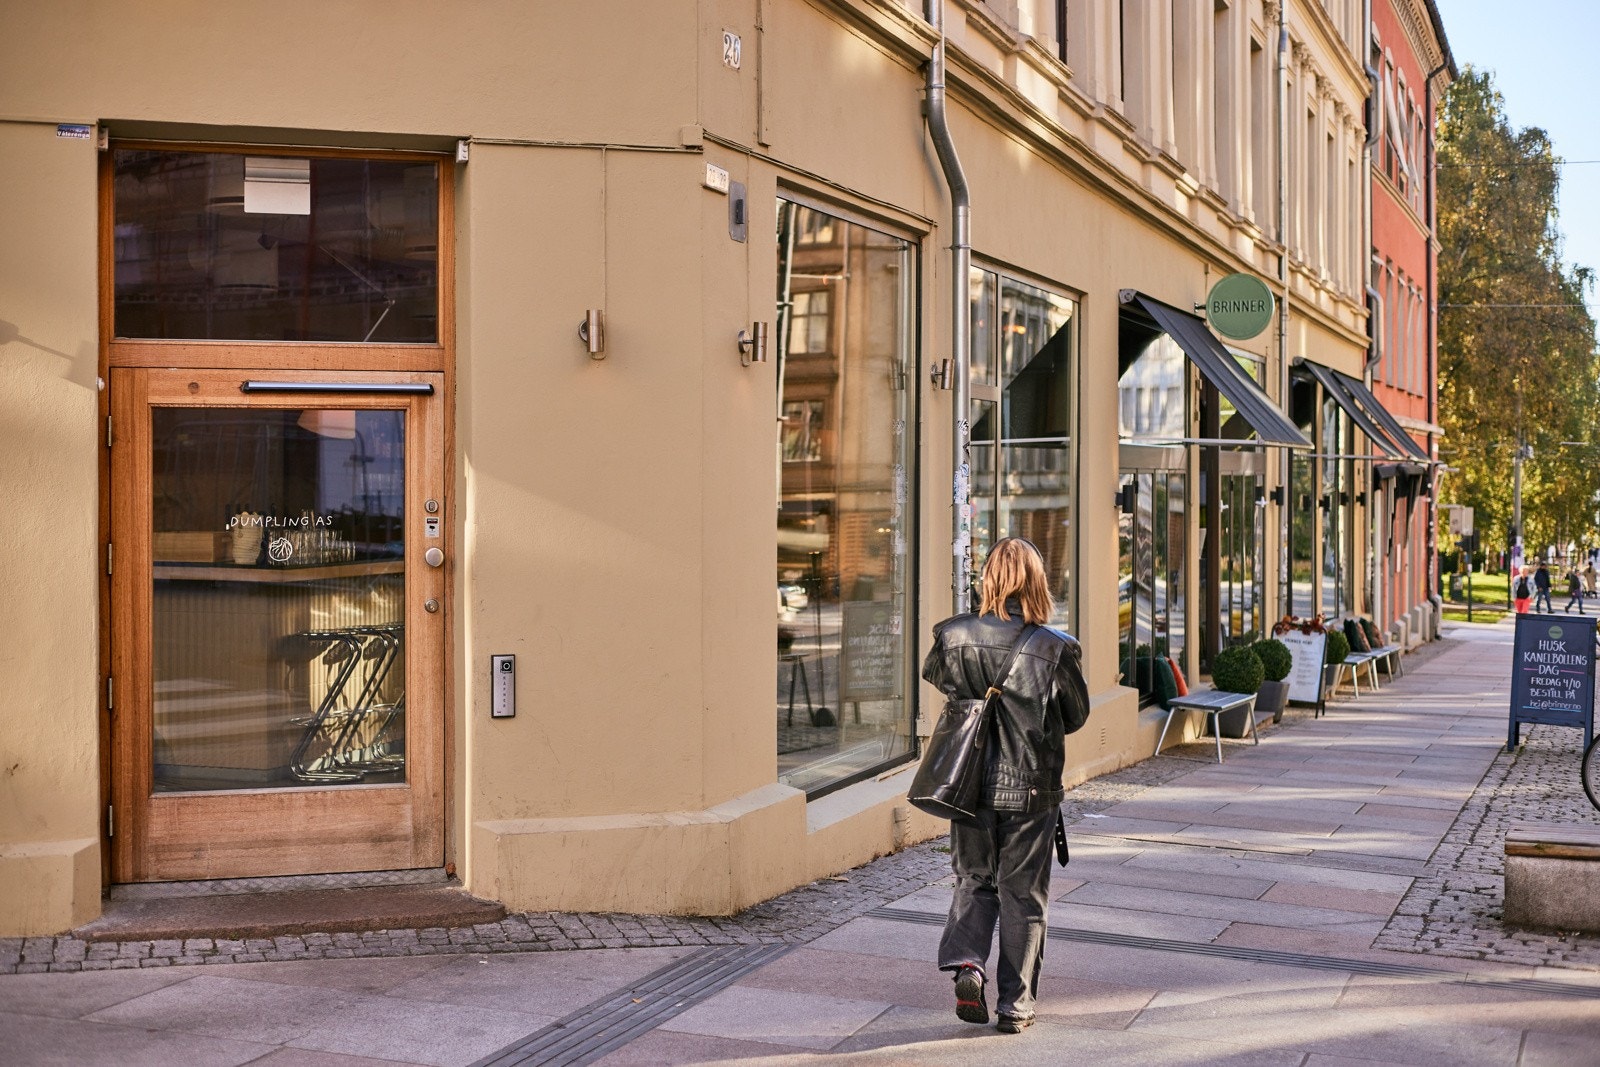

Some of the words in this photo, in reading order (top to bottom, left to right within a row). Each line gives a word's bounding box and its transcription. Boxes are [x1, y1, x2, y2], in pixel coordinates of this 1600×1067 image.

[1213, 300, 1265, 313] BRINNER
[230, 516, 309, 527] DUMPLING
[316, 516, 333, 526] AS
[1539, 640, 1567, 652] HUSK
[1523, 652, 1588, 666] KANELBOLLENS
[1538, 665, 1560, 675] DAG
[1530, 677, 1561, 686] FREDAG
[1563, 678, 1581, 690] 4/10
[1529, 688, 1563, 699] BESTILL
[1565, 689, 1576, 700] PÅ
